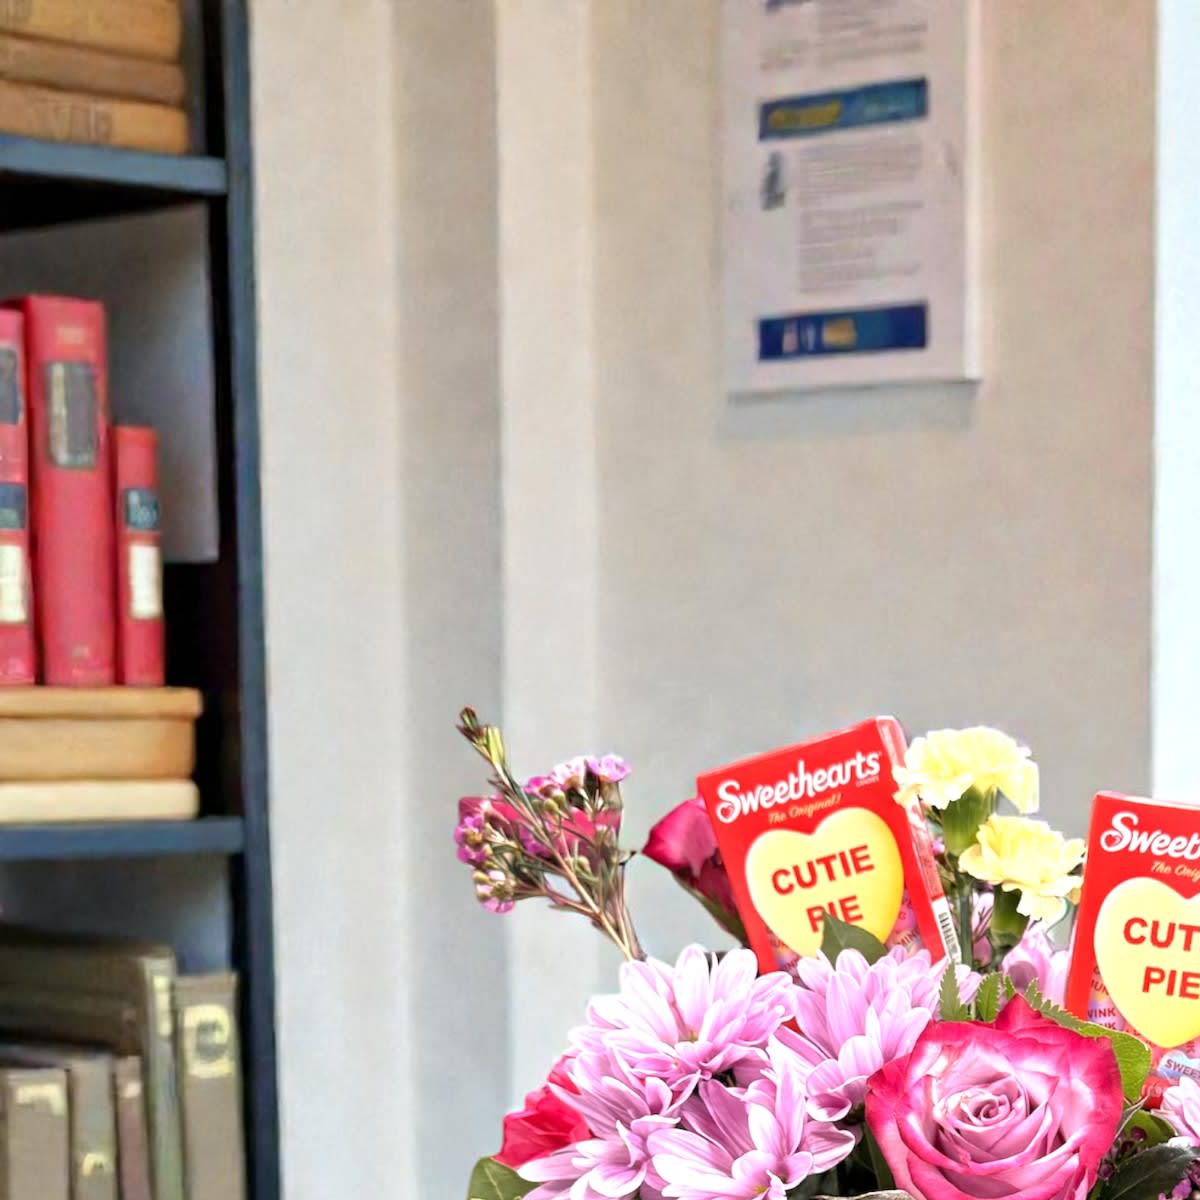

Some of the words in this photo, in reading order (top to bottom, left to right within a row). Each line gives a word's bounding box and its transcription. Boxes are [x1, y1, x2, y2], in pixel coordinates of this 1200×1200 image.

[716, 752, 880, 824] Sweethearts
[768, 811, 786, 825] The
[788, 793, 842, 818] Original!
[771, 844, 875, 895] CUTIE
[1150, 861, 1173, 875] The
[806, 895, 864, 934] PIE
